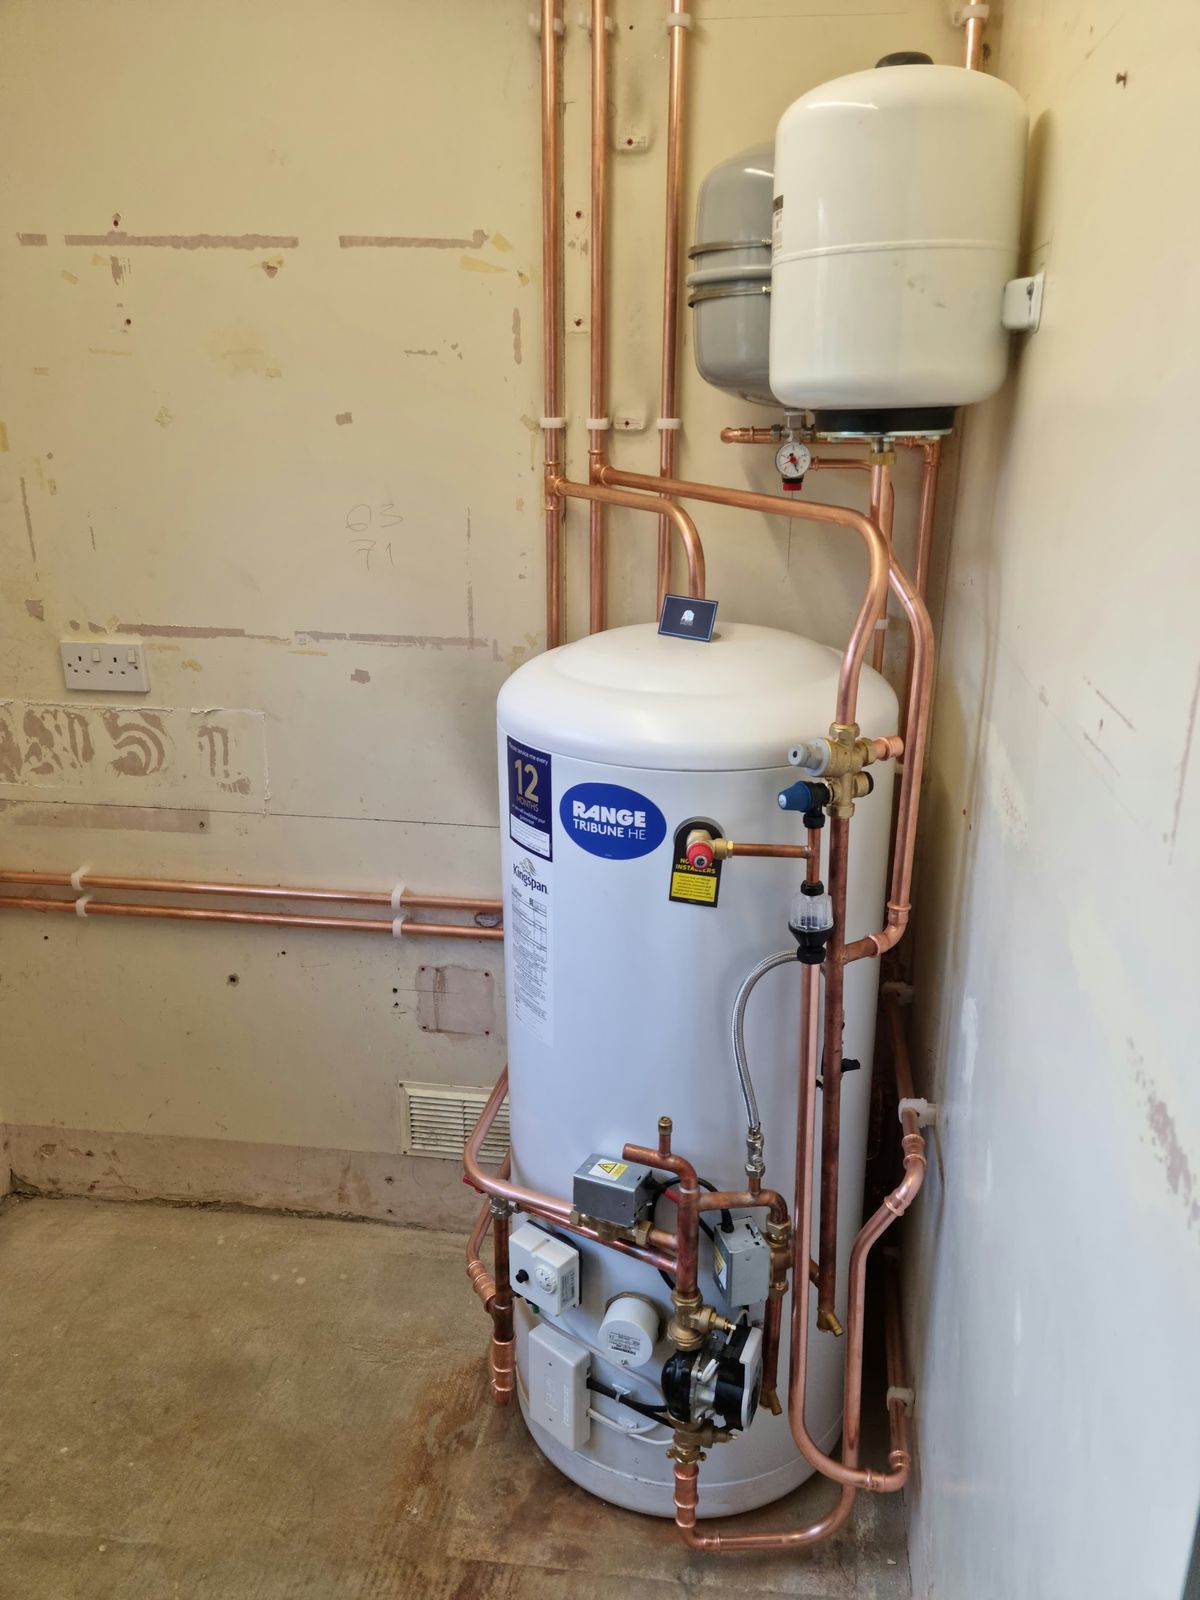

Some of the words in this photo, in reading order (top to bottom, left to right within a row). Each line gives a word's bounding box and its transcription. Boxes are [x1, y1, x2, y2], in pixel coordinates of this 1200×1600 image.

[536, 757, 549, 767] every
[514, 759, 539, 802] 12
[516, 794, 539, 812] MONTHS
[573, 800, 646, 828] RANGE
[573, 818, 624, 838] TRIBUNE
[628, 828, 647, 840] HE
[512, 863, 548, 894] Kingspan
